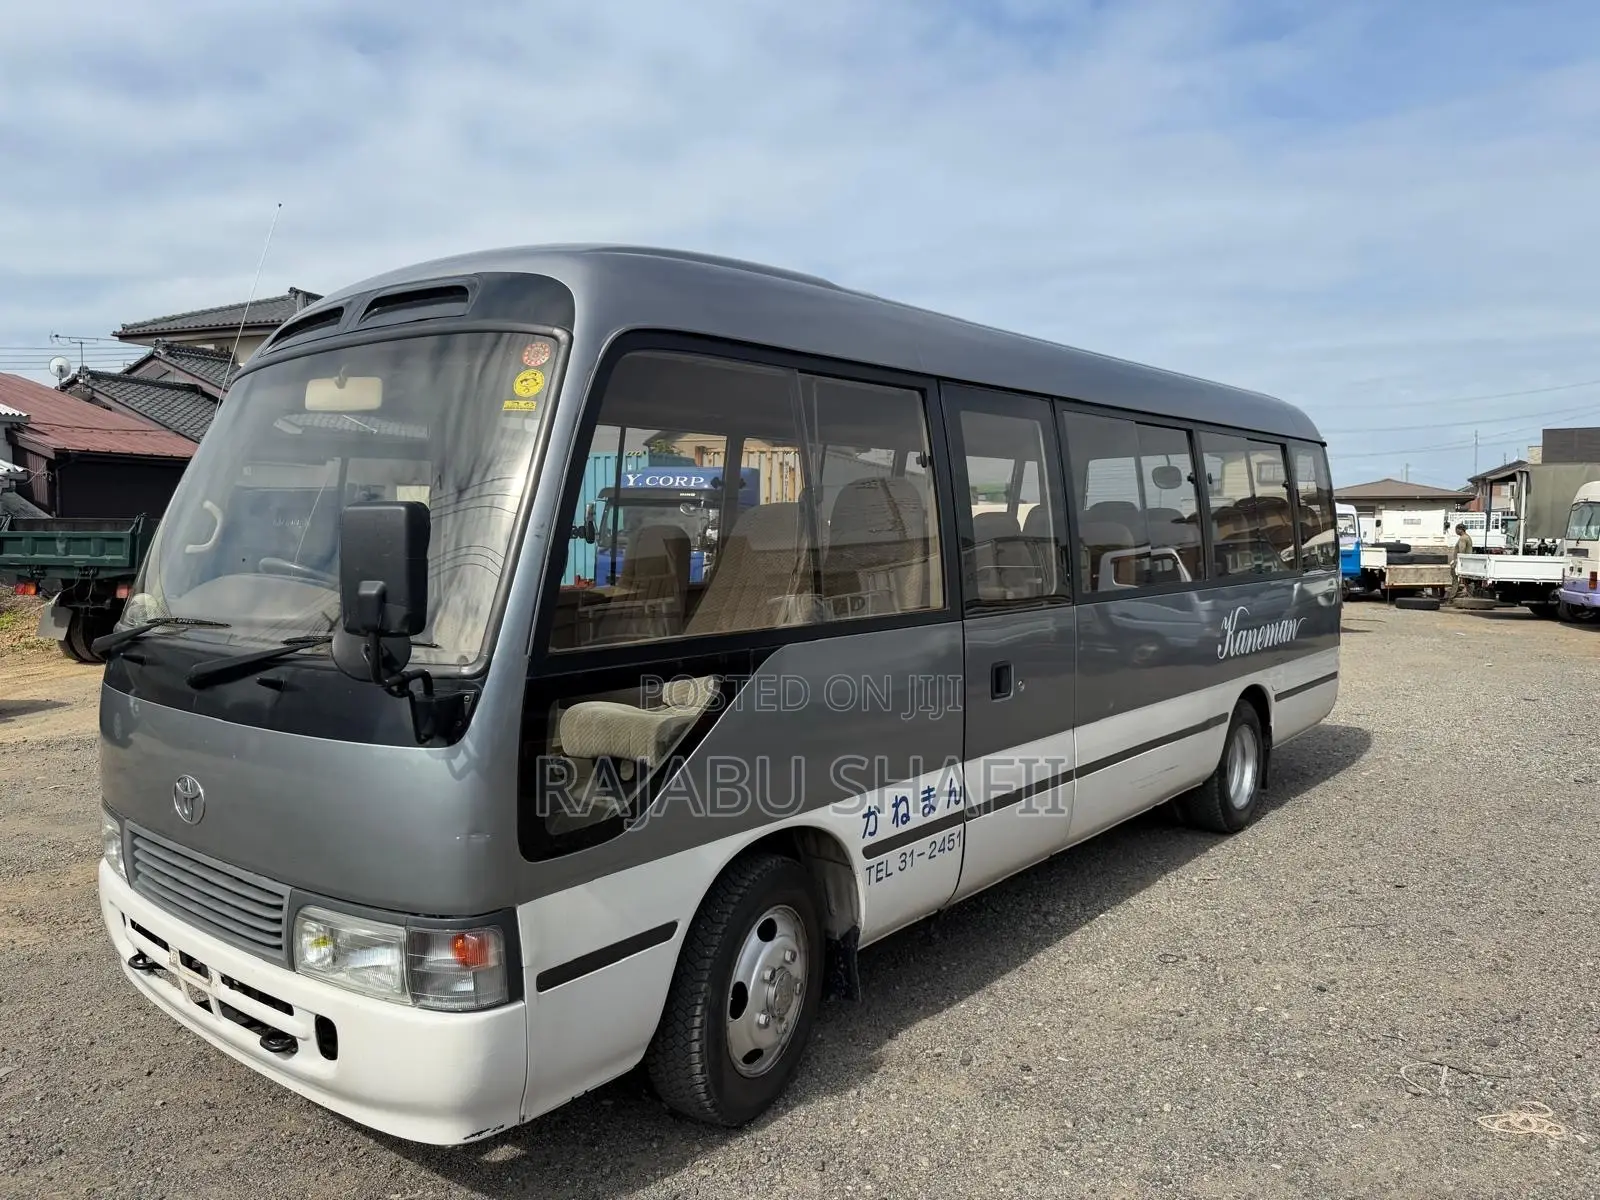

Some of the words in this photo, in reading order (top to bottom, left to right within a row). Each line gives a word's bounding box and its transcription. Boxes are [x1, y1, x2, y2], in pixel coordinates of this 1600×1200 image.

[1217, 606, 1307, 659] Kaneman
[861, 778, 962, 839] かねまん
[865, 859, 893, 886] TEL
[898, 830, 962, 872] 31-2451
